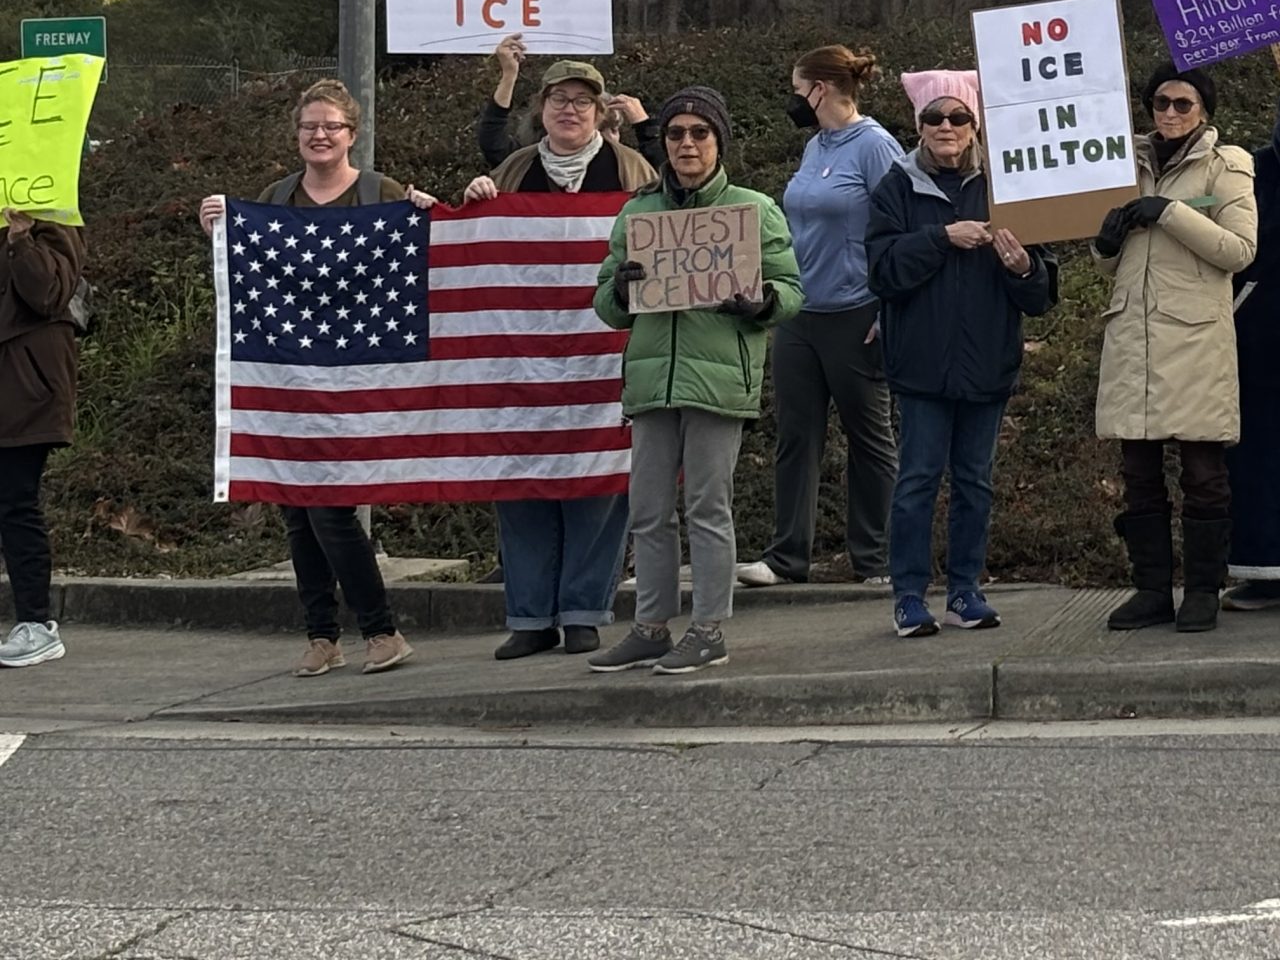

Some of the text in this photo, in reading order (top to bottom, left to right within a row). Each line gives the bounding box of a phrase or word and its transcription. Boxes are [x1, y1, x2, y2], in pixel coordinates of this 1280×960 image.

[1021, 17, 1069, 47] NO
[1217, 13, 1264, 34] Billion
[35, 32, 91, 46] FREEWAY
[1210, 37, 1240, 58] year
[1243, 28, 1280, 44] from
[1021, 51, 1084, 82] ICE
[1038, 103, 1077, 132] IN
[1002, 135, 1127, 174] HILTON
[631, 207, 752, 251] DIVEST
[653, 244, 734, 275] FROM
[636, 268, 760, 309] ICE NOW
